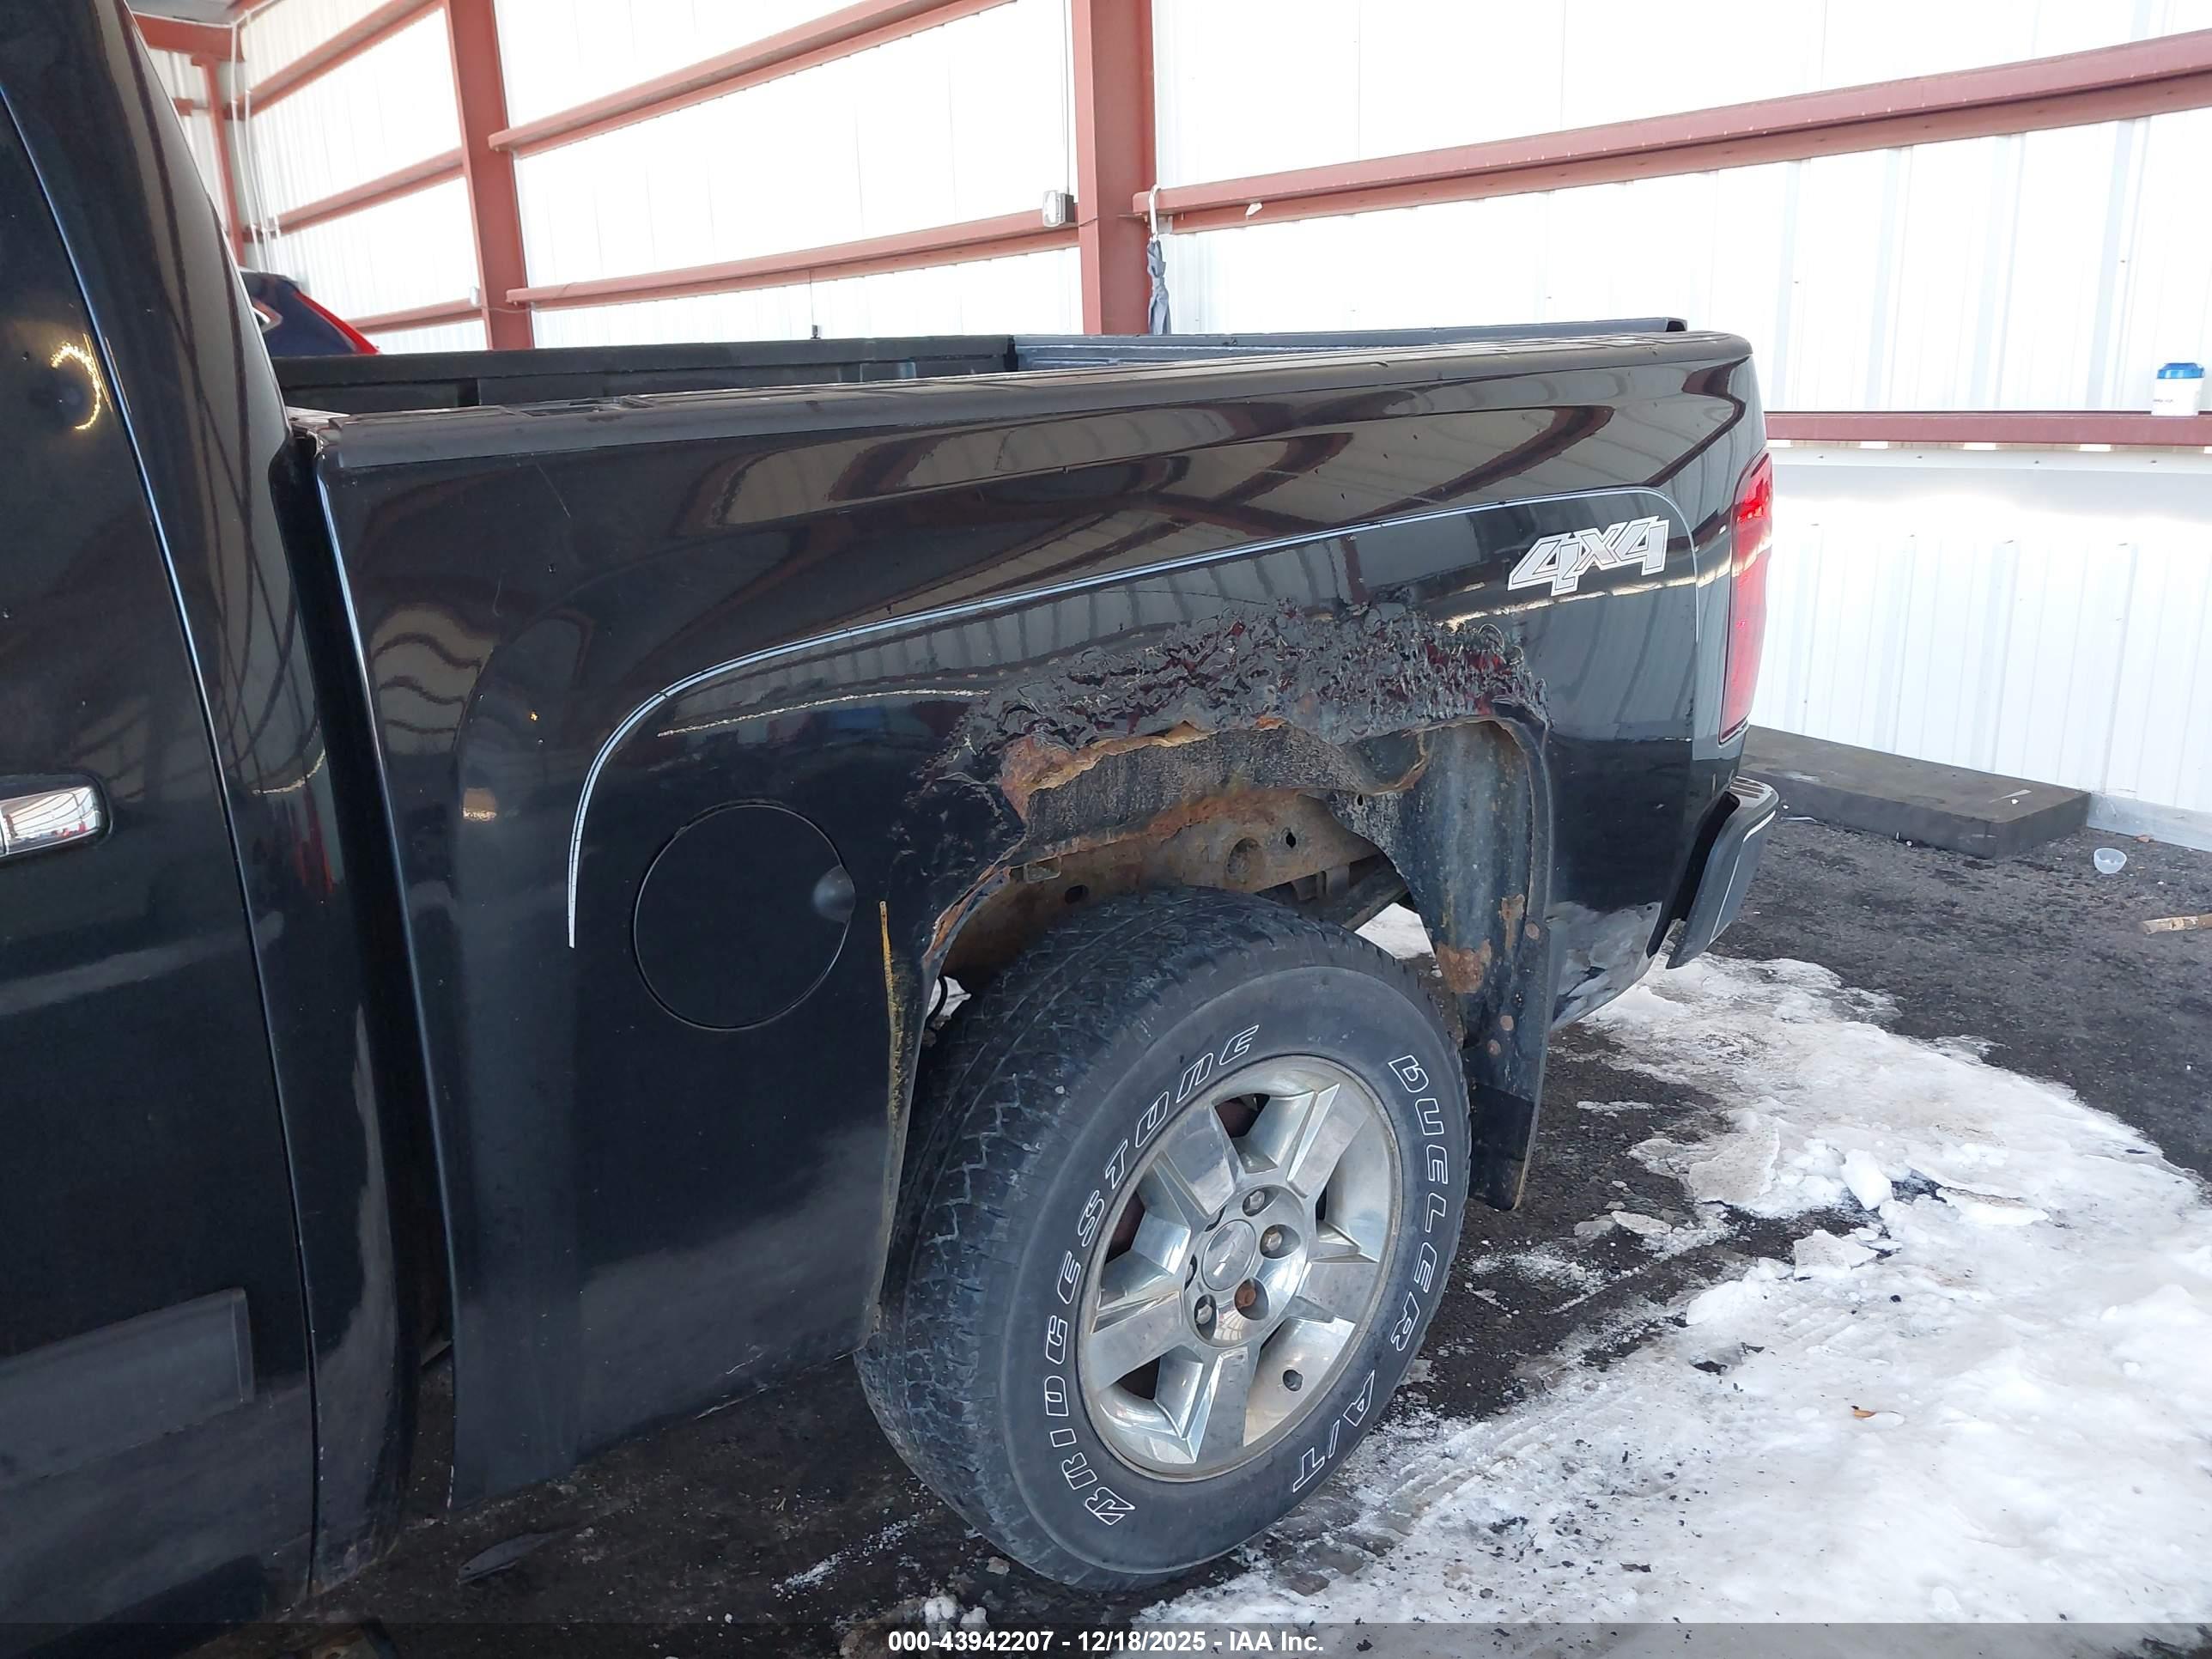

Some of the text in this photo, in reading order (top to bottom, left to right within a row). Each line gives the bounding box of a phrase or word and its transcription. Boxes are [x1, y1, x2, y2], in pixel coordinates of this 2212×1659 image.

[1044, 1024, 1260, 1526] BRIDGESTONE
[1292, 1054, 1449, 1494] DUELER A/T
